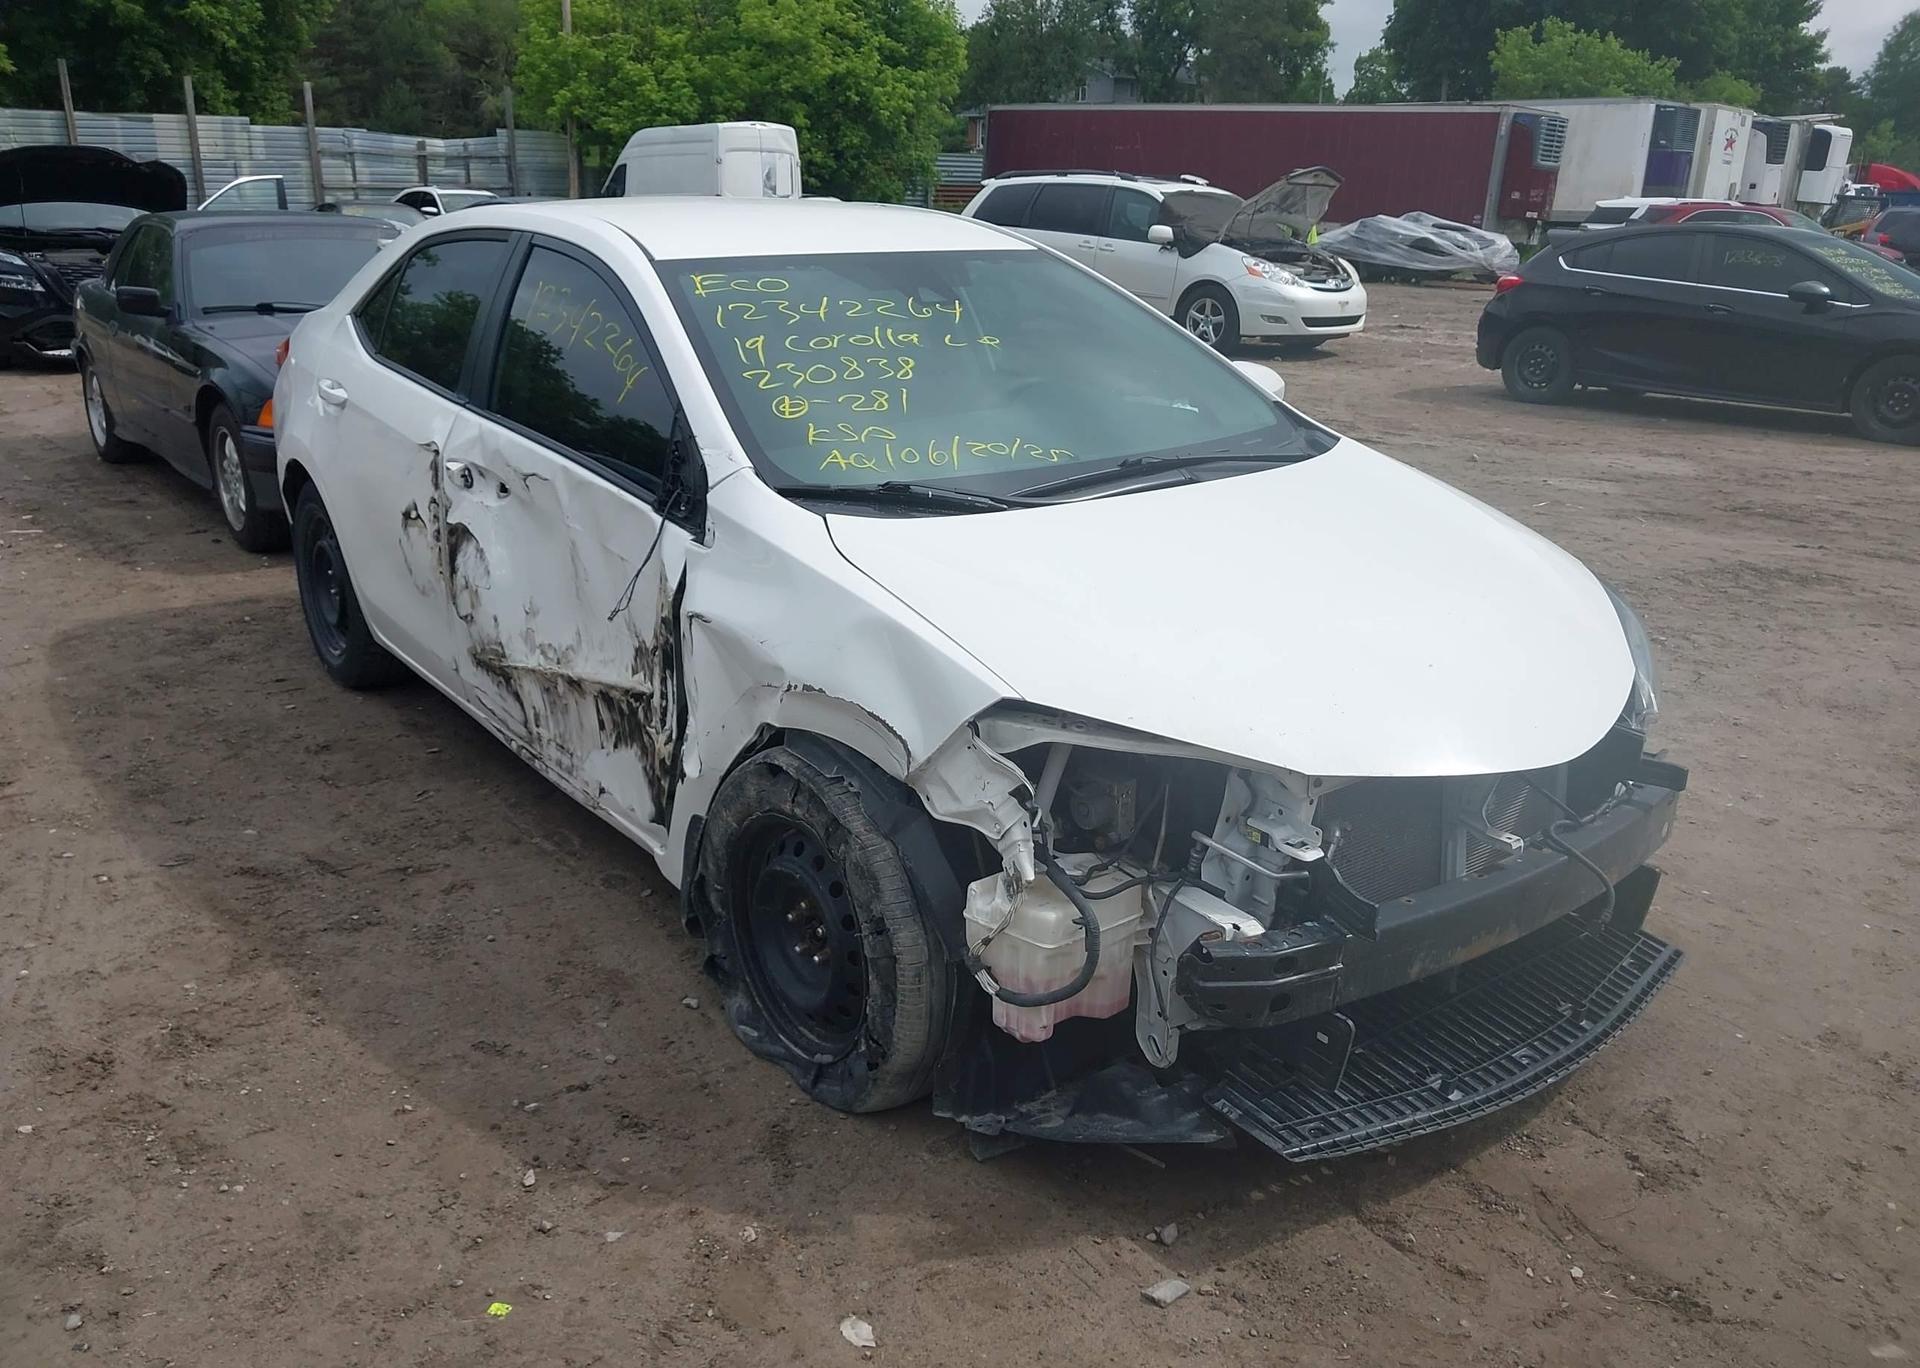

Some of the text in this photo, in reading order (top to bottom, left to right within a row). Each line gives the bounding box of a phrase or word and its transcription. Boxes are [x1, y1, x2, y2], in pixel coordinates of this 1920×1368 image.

[716, 296, 963, 329] 12342264
[734, 334, 766, 367] 19
[742, 356, 915, 389] 230838
